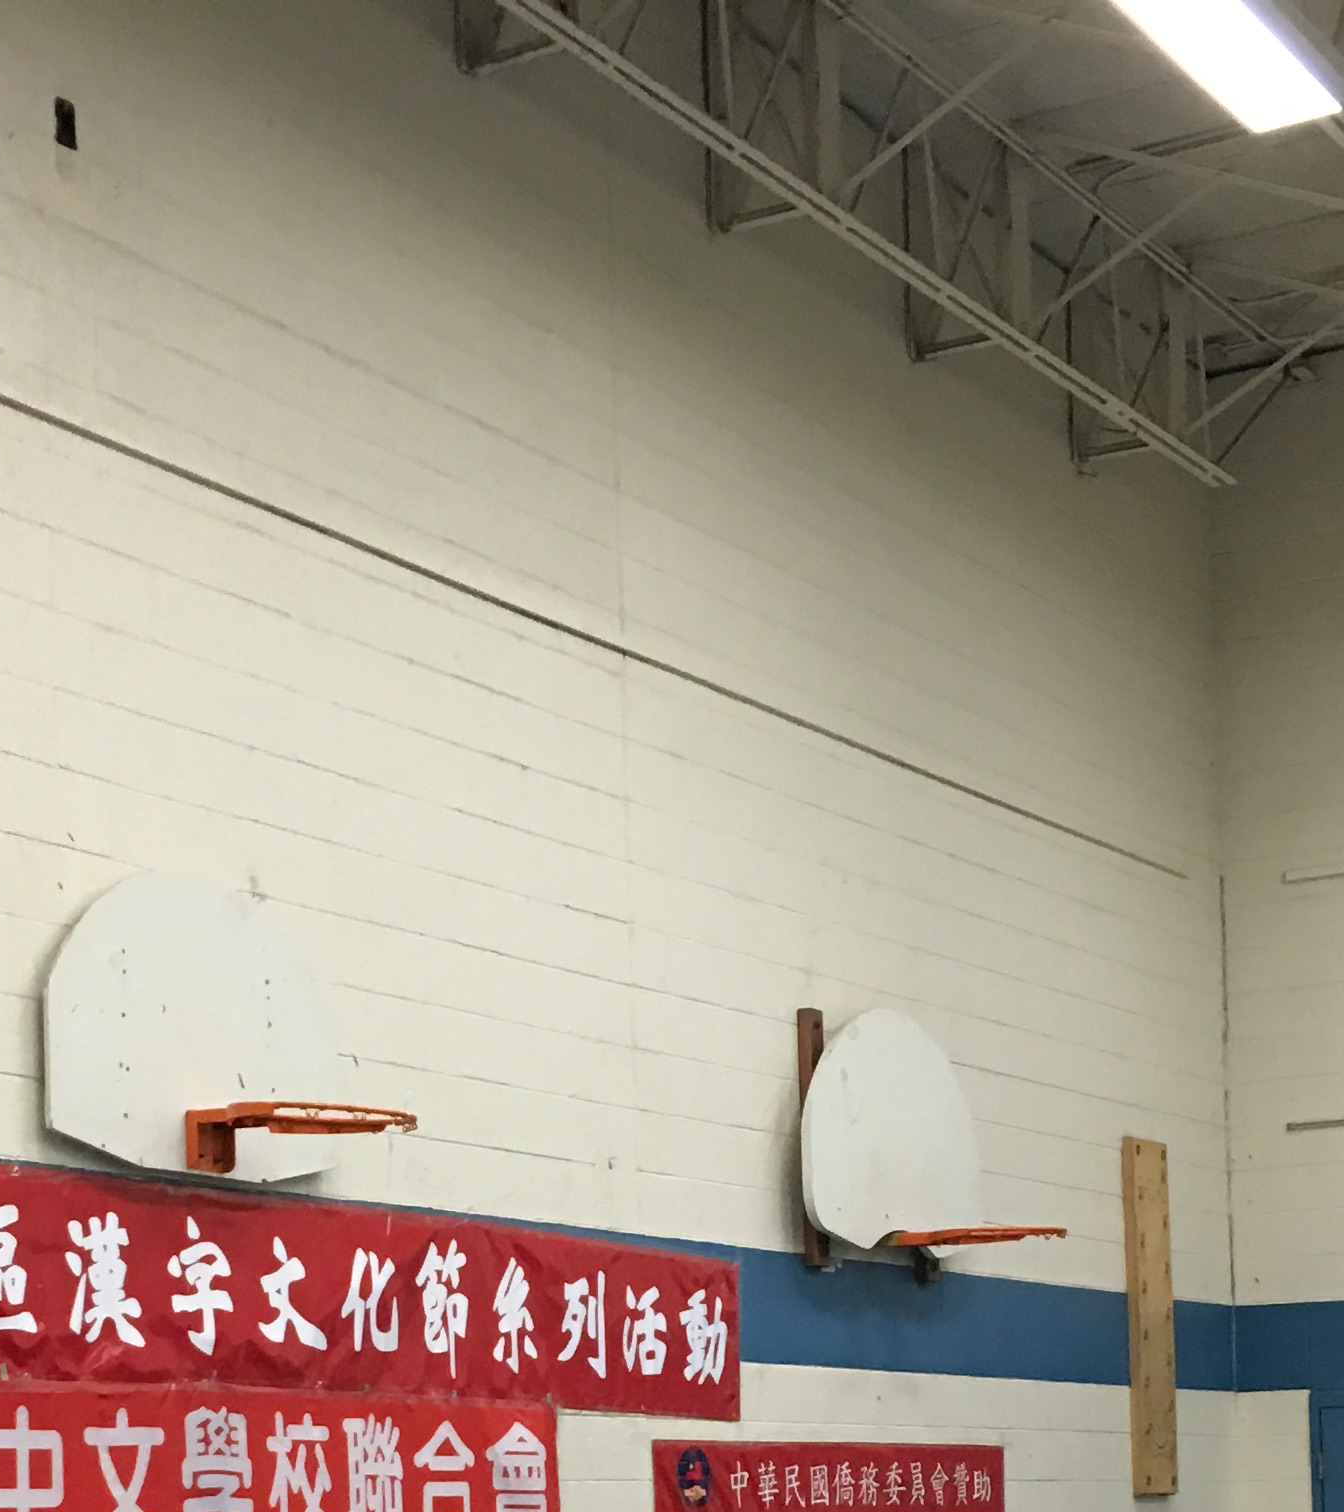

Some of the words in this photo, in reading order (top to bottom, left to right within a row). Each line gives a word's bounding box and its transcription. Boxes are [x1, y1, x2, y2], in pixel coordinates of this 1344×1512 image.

[730, 1461, 992, 1508] 中華民國僑務委員會贊助
